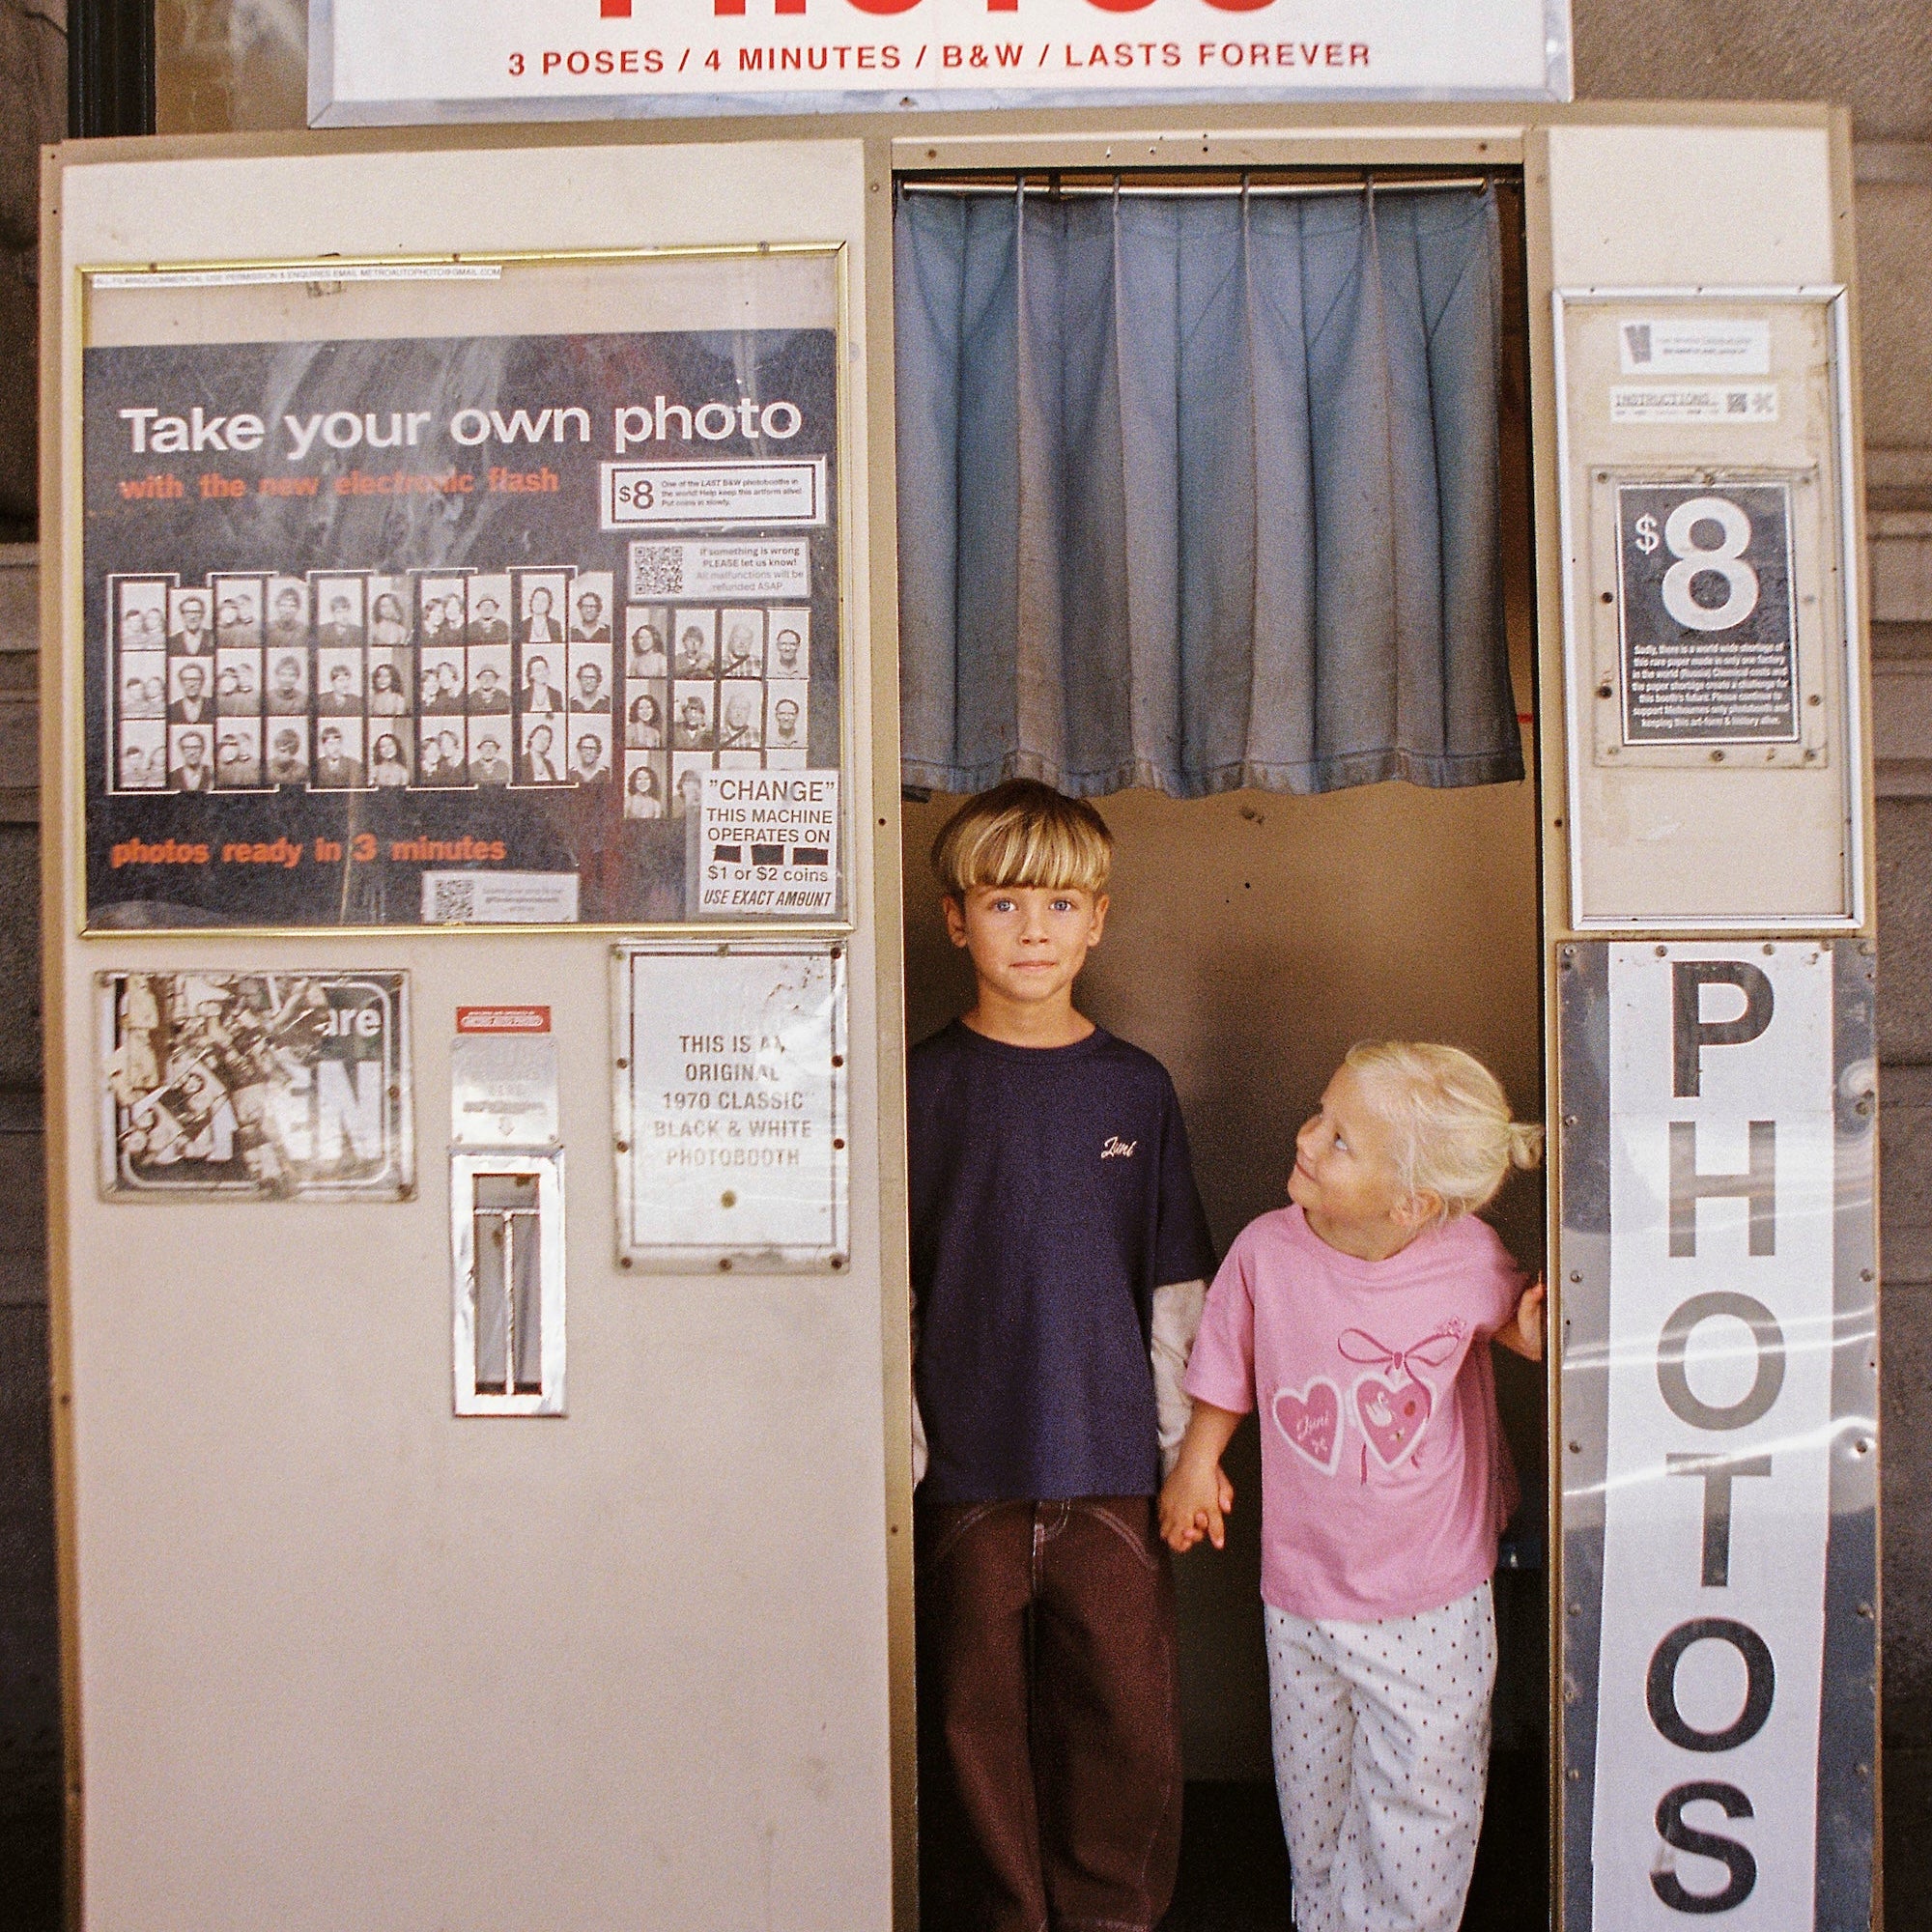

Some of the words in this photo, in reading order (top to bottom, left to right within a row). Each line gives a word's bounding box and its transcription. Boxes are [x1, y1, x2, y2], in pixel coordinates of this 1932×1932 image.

[508, 52, 526, 77] 3
[542, 48, 665, 76] POSES
[678, 47, 691, 72] /
[704, 47, 722, 71] 4
[738, 44, 901, 71] MINUTES
[915, 44, 927, 69] /
[942, 43, 1024, 69] B&W
[1038, 43, 1050, 67] /
[1065, 43, 1181, 69] LASTS
[1198, 43, 1369, 68] FOREVER
[118, 407, 266, 454] Take
[284, 409, 431, 461] your
[450, 406, 590, 447] own
[613, 395, 803, 454] photo
[120, 474, 184, 499] with
[198, 472, 246, 498] the
[259, 476, 319, 497] new
[334, 469, 474, 496] electronic
[488, 467, 559, 493] flash
[618, 479, 654, 510] $8
[700, 547, 706, 555] If
[709, 547, 758, 556] something
[760, 546, 769, 554] is
[770, 547, 800, 556] wrong
[741, 558, 754, 567] let
[1634, 496, 1761, 632] $8
[711, 570, 771, 579] malfunctions
[713, 582, 756, 591] refunded
[706, 808, 746, 822] THIS
[752, 810, 833, 823] MACHINE
[707, 828, 799, 842] OPERATES
[805, 830, 830, 842] ON
[111, 838, 210, 868] photos
[223, 837, 303, 868] ready
[314, 837, 342, 862] in
[351, 833, 378, 863] 3
[391, 834, 507, 862] minutes
[707, 866, 726, 880] $1
[734, 870, 752, 881] or
[756, 867, 778, 881] $2
[783, 868, 828, 882] coins
[704, 890, 729, 904] USE
[732, 890, 775, 905] EXACT
[679, 1036, 724, 1053] THIS
[732, 1036, 751, 1053] IS
[685, 1064, 781, 1082] ORIGINAL
[663, 1092, 711, 1109] 1970
[718, 1092, 804, 1109] CLASSIC
[654, 1120, 720, 1138] BLACK
[727, 1121, 741, 1137] &
[749, 1120, 812, 1139] WHITE
[667, 1148, 800, 1166] PHOTOBOOTH
[1646, 959, 1787, 1915] PHOTOS
